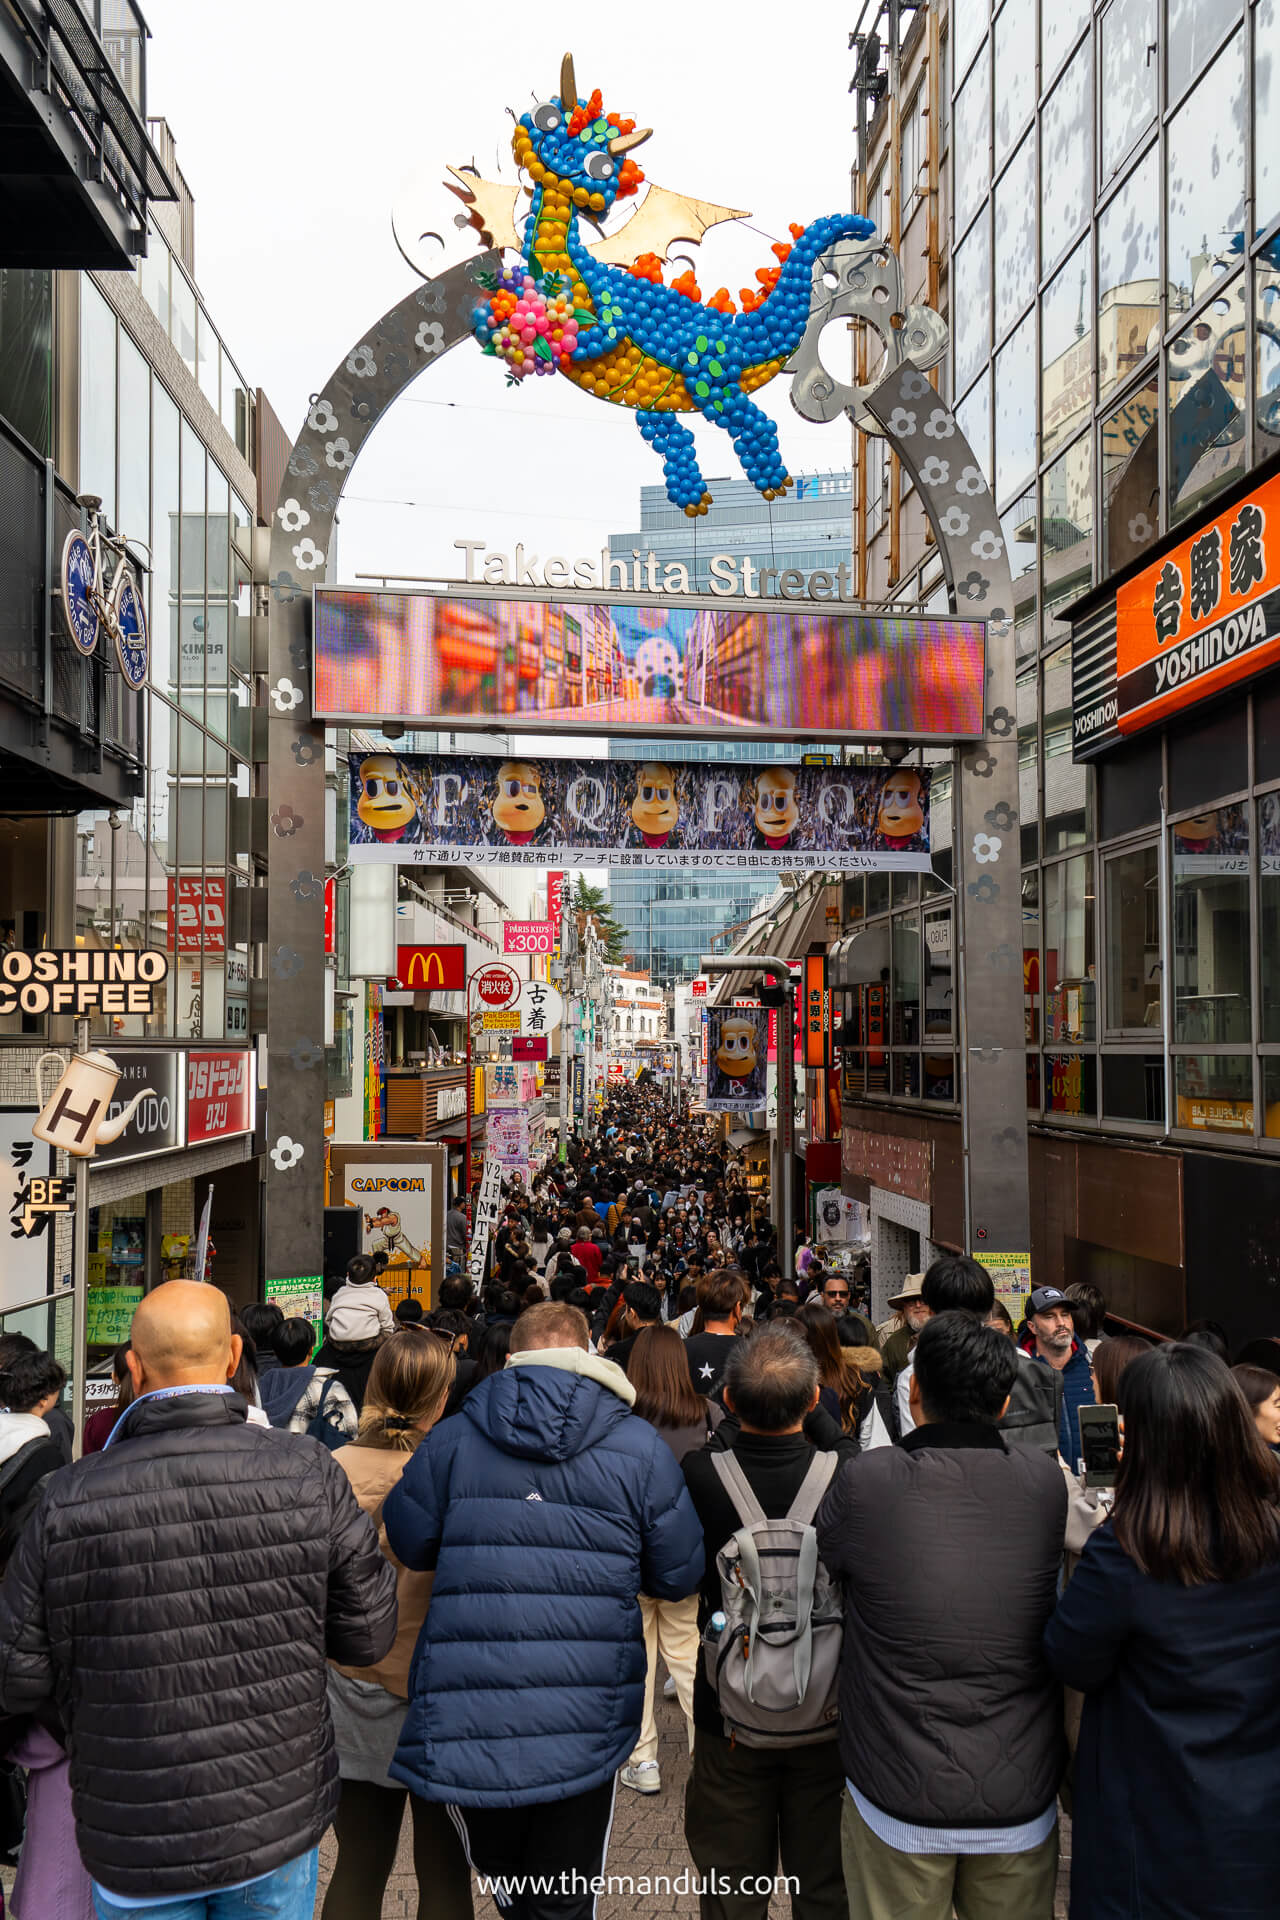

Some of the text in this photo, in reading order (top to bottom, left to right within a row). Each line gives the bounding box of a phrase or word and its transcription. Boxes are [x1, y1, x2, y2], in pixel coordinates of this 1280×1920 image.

[454, 540, 852, 600] Takeshita Street
[1155, 604, 1266, 693] YOSHINOYA
[510, 924, 529, 933] PARIS
[508, 935, 549, 951] ¥300
[0, 983, 151, 1014] COFFEE
[481, 981, 511, 995] 消火栓
[527, 984, 548, 1030] 古着
[119, 1066, 147, 1079] AMEN
[205, 1101, 228, 1132] クスリ
[31, 1179, 63, 1204] BF
[351, 1177, 426, 1192] CAPCOM
